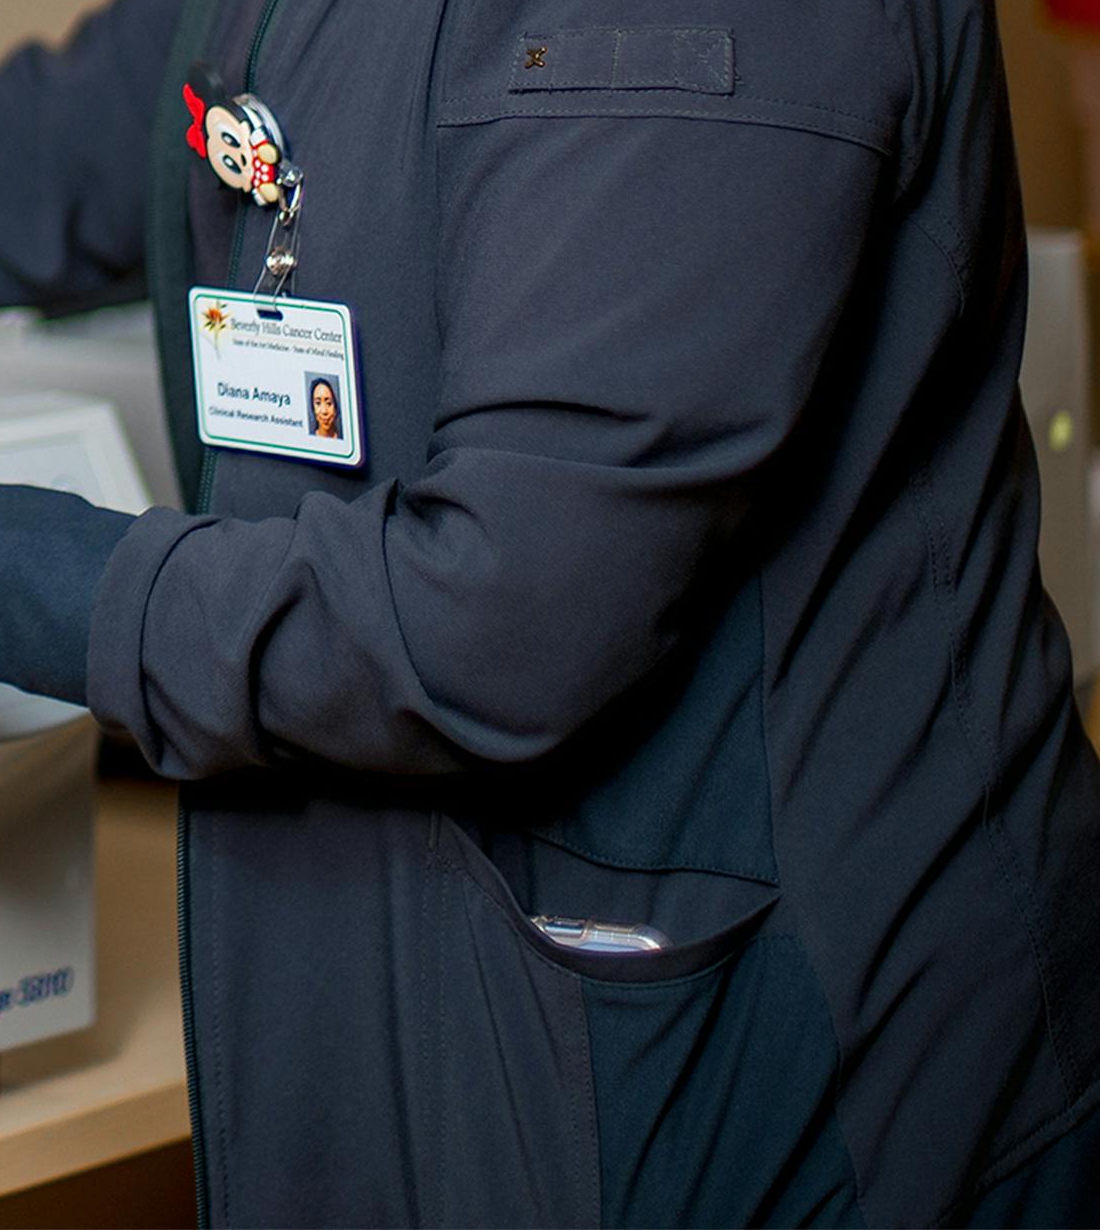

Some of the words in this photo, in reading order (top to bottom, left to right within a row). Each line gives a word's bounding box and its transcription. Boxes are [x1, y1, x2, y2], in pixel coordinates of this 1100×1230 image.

[231, 318, 260, 335] Beverly
[262, 321, 280, 335] Hills
[283, 324, 312, 339] Cancer
[314, 328, 342, 343] Center
[217, 382, 250, 400] Diana
[252, 387, 291, 408] Amaya
[208, 406, 234, 418] Clinical
[236, 410, 269, 423] Research
[271, 415, 303, 427] Assistant
